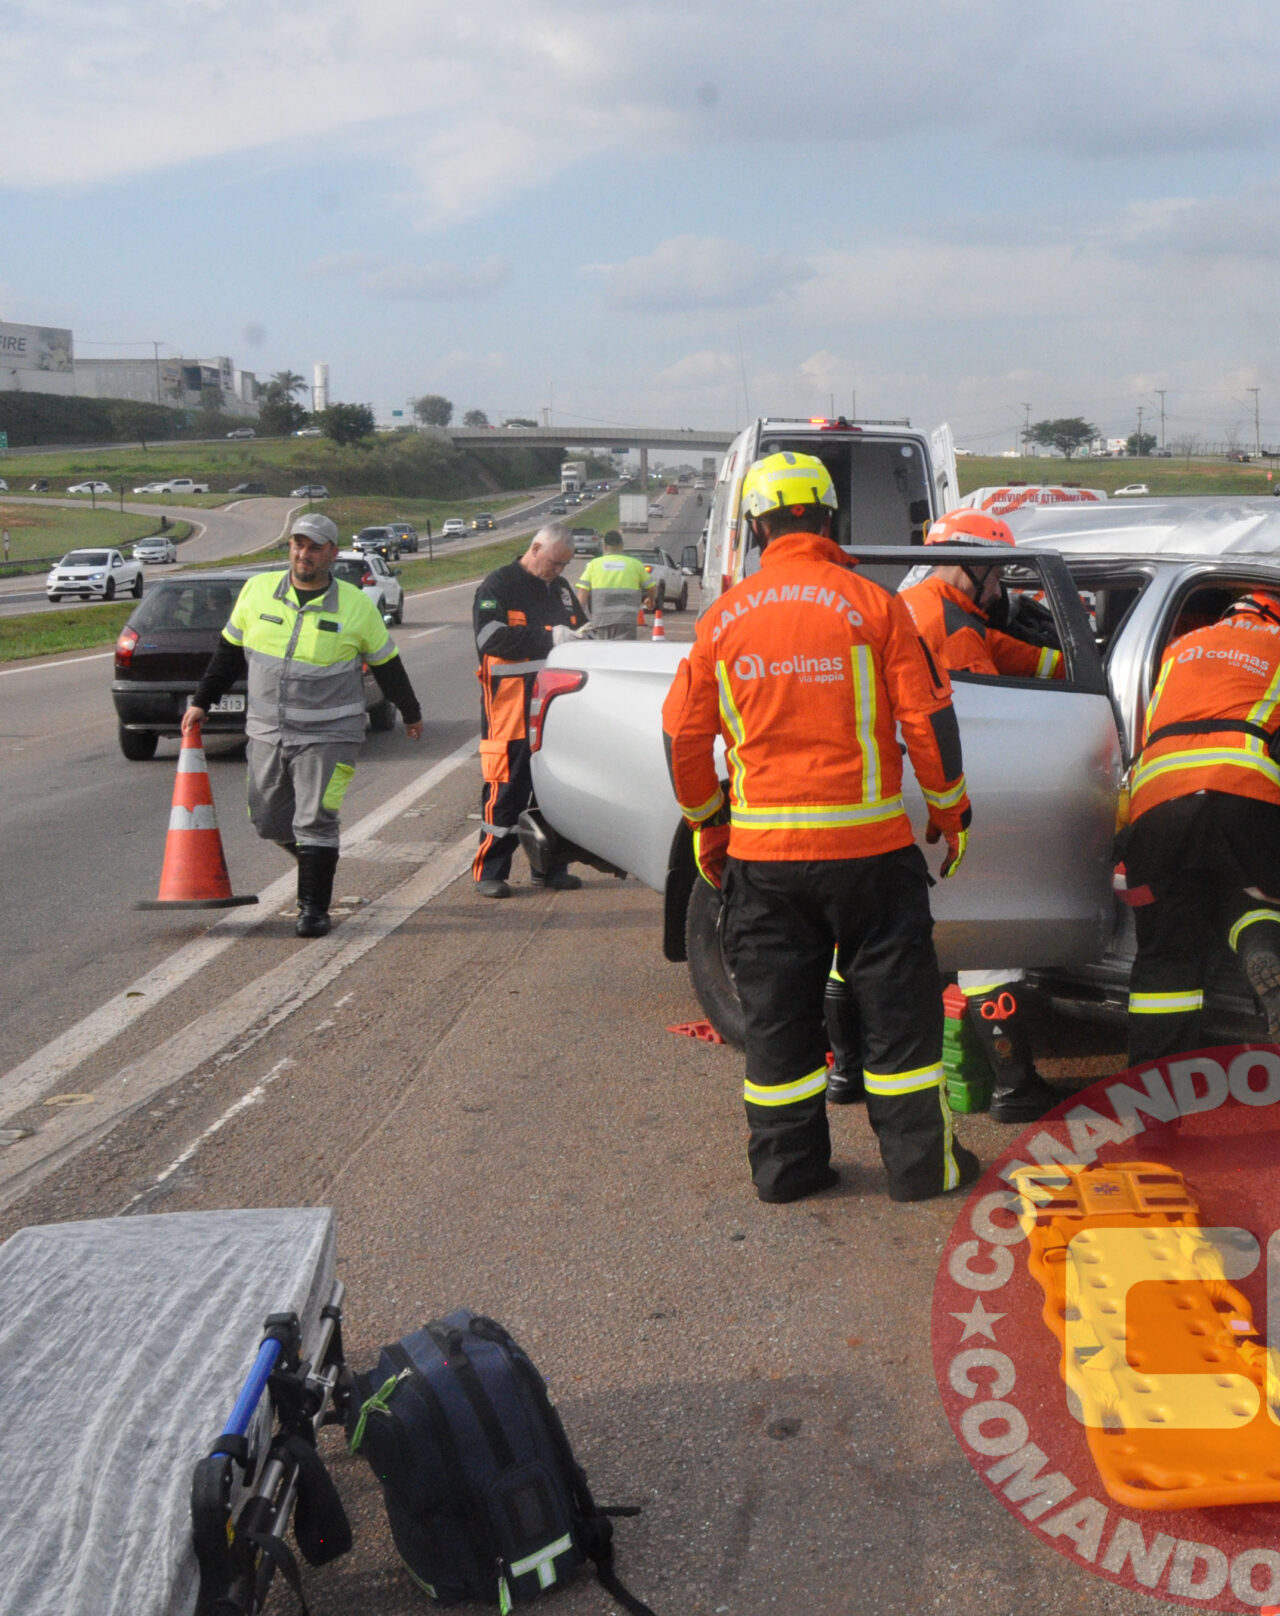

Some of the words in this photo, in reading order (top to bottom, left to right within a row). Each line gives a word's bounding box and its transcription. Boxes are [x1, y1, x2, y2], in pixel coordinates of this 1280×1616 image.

[0, 335, 27, 352] IRE
[991, 493, 1027, 503] SERVIÇO
[1029, 493, 1039, 503] DE
[769, 655, 843, 676] colinas
[1206, 649, 1270, 671] colinas
[798, 675, 813, 683] via
[815, 672, 844, 684] appia
